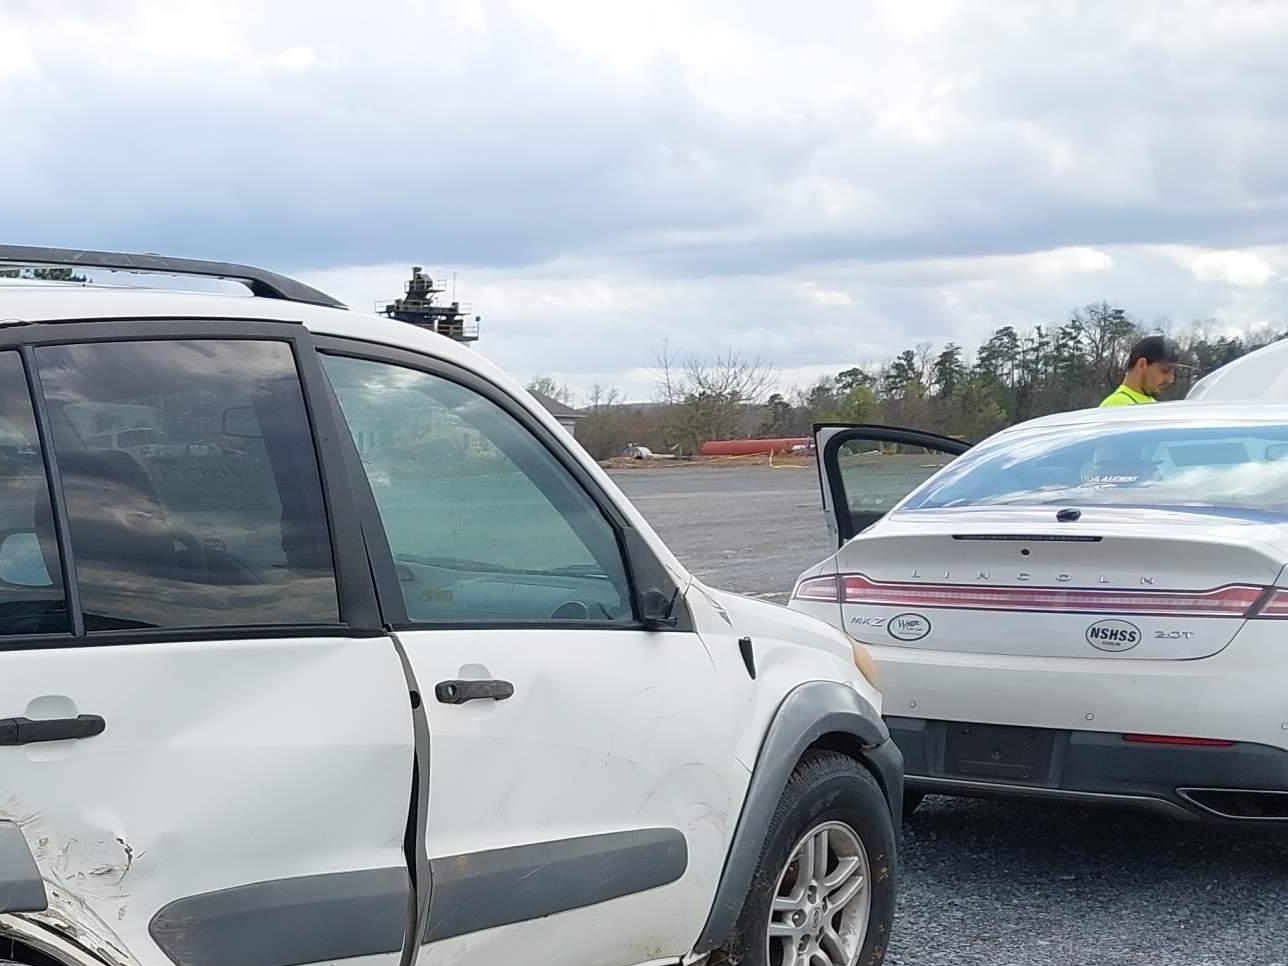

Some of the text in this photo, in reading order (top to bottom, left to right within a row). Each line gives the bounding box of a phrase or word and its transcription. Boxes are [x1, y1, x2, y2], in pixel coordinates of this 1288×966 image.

[911, 568, 1155, 586] LINCOLN
[850, 615, 887, 628] MKZ
[1089, 626, 1138, 643] NSHSS
[1153, 630, 1196, 640] 2.0T
